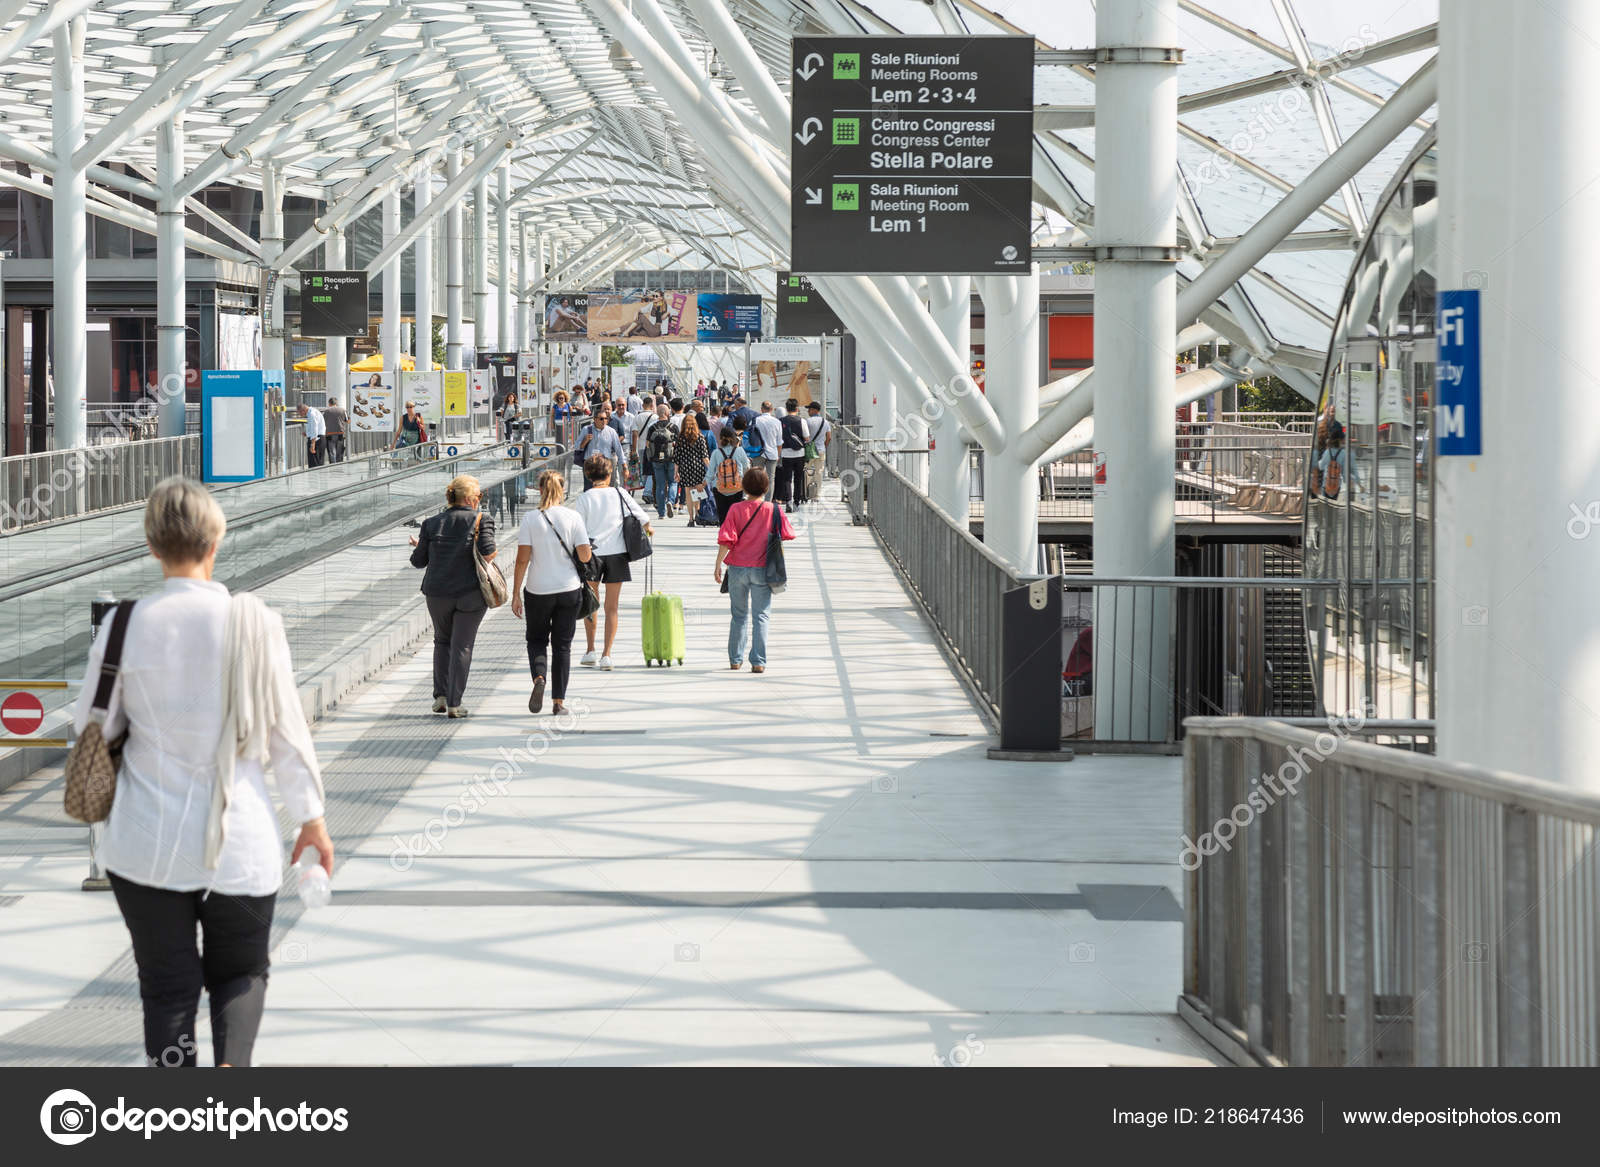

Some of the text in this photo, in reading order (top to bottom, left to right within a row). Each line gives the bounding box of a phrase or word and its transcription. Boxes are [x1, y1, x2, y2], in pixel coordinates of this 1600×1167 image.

[870, 52, 960, 65] Sale Riunioni
[871, 68, 978, 82] Meeting Rooms
[871, 86, 912, 104] Lem
[871, 118, 996, 134] Centro Congressi
[871, 133, 991, 149] Congress Center
[870, 151, 994, 169] Stella Polare
[870, 184, 959, 196] Sala Riunioni
[870, 200, 970, 213] Meeting Room
[870, 216, 926, 233] Lem 1
[324, 276, 360, 284] Reception
[697, 316, 718, 326] ESA
